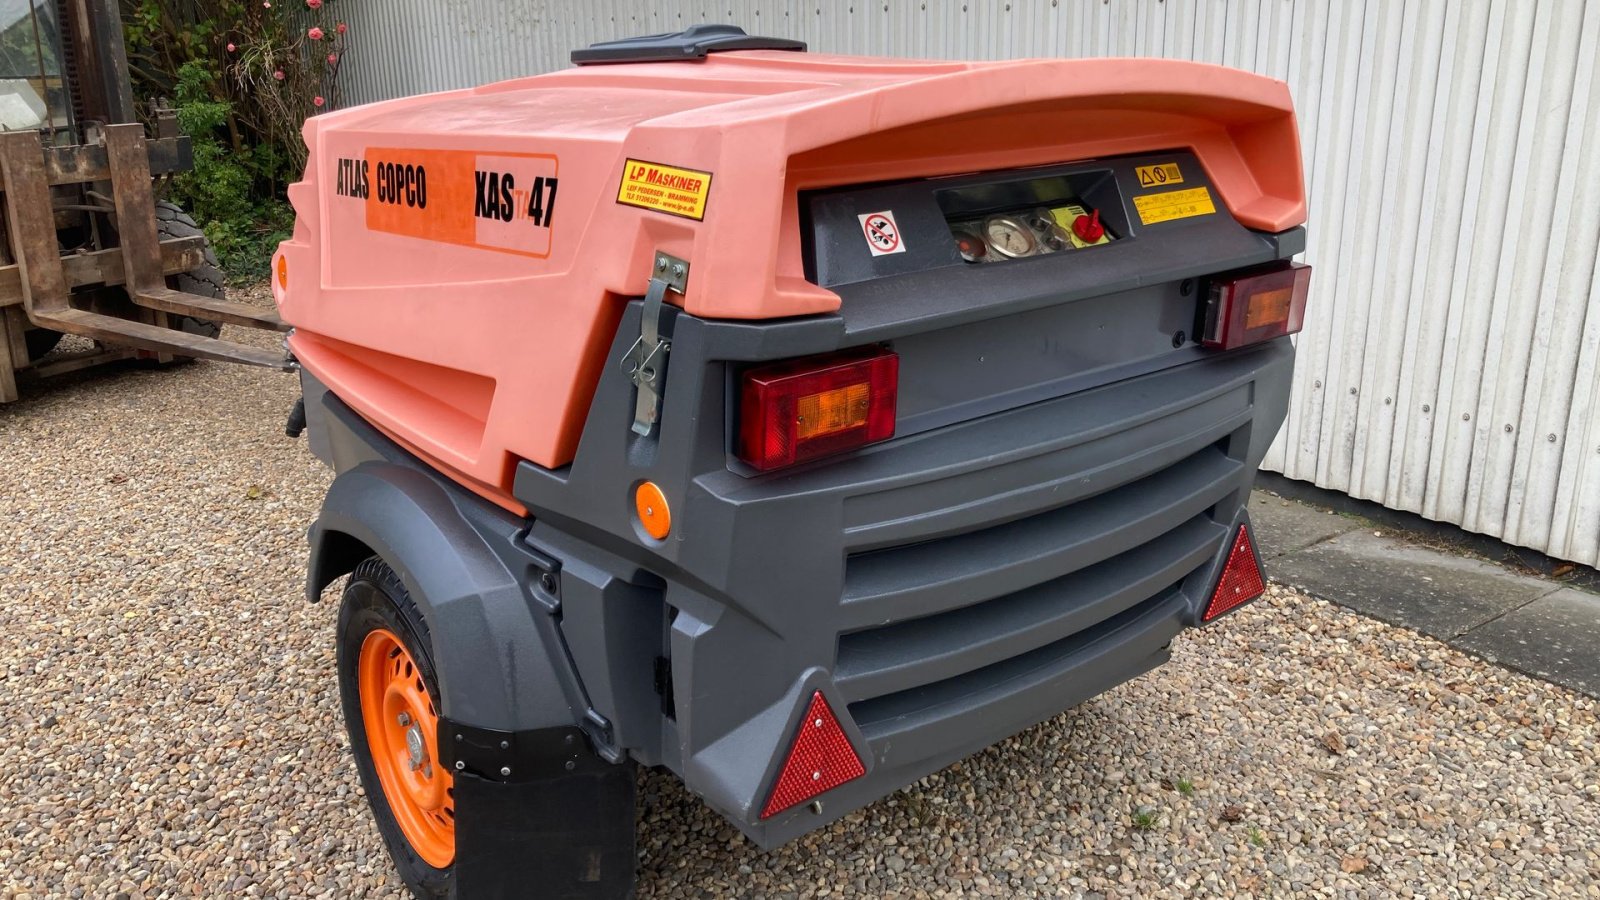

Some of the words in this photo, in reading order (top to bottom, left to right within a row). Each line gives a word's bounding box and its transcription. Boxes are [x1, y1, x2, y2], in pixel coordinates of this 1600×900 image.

[337, 158, 370, 200] ATLAS
[376, 161, 427, 209] COPCO
[629, 165, 646, 181] LP
[645, 168, 702, 193] MASKINER
[637, 186, 664, 197] PEDERSEN
[667, 192, 698, 204] BRAMMING
[475, 170, 515, 222] XAS
[528, 176, 558, 228] 47
